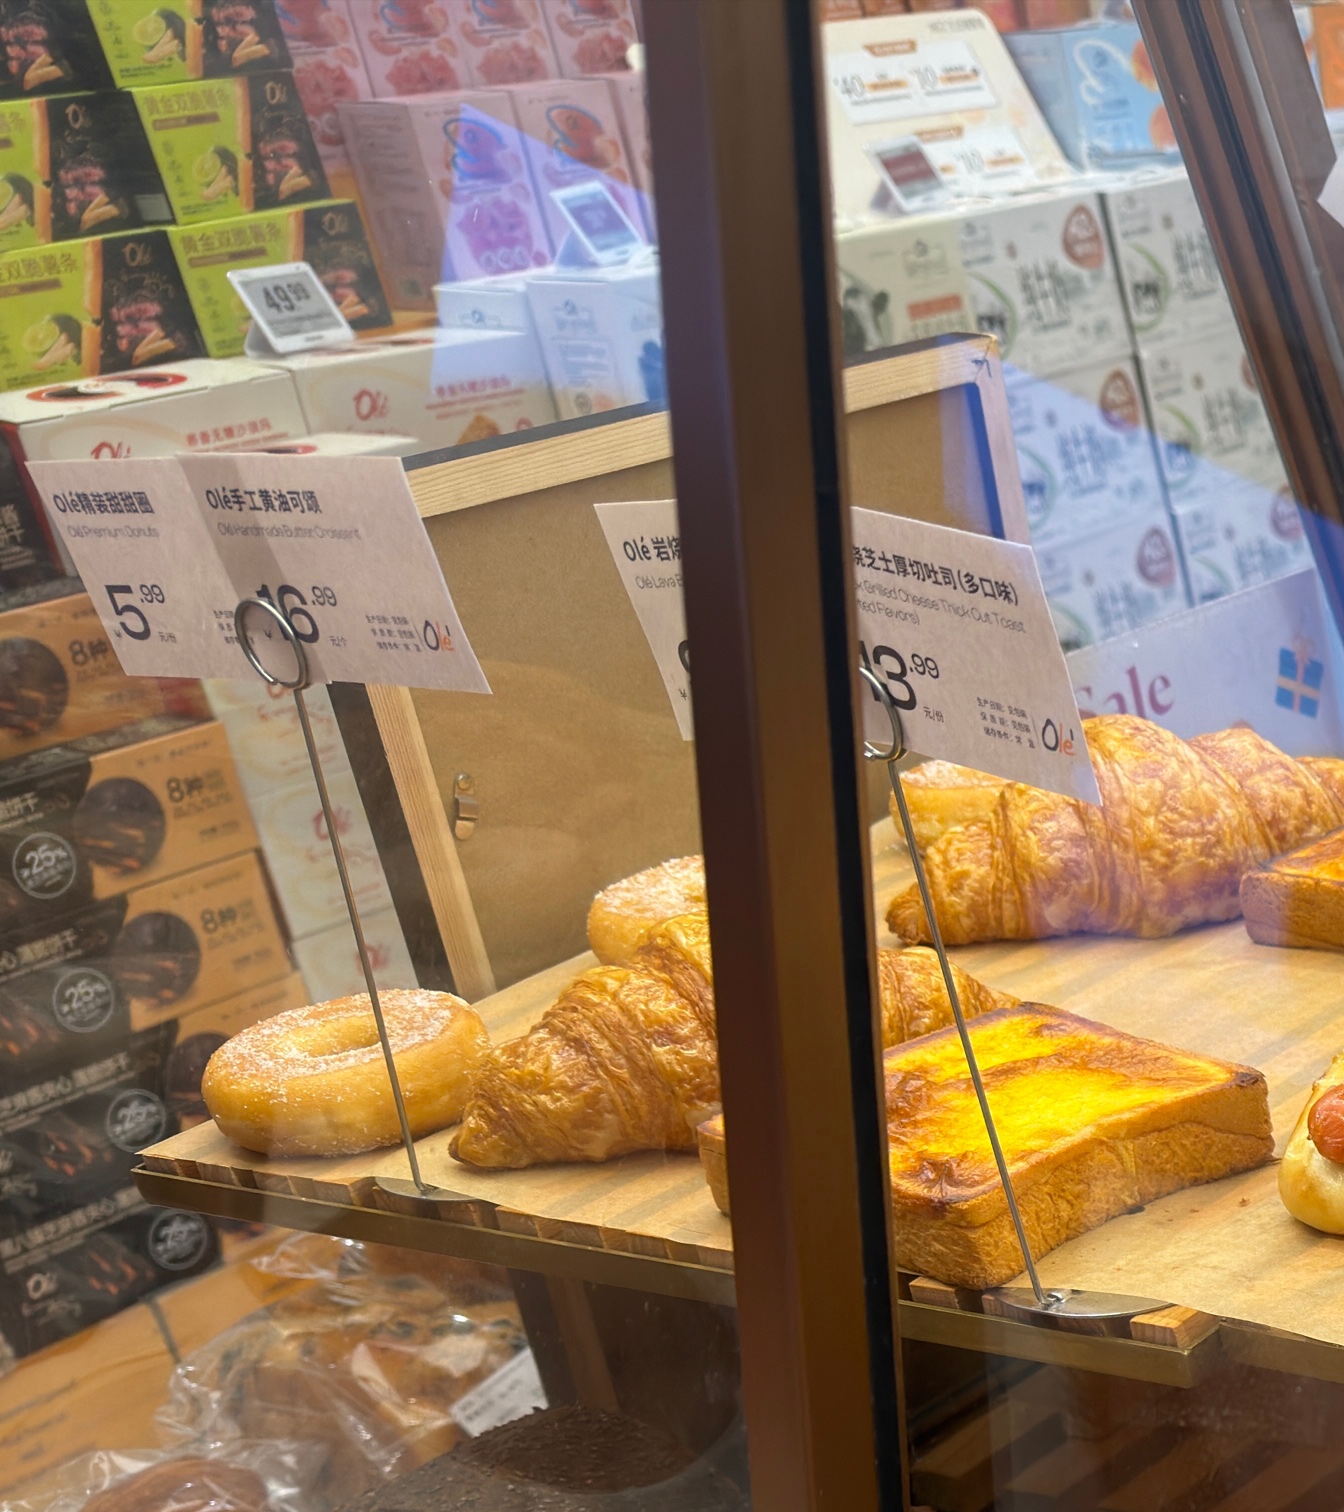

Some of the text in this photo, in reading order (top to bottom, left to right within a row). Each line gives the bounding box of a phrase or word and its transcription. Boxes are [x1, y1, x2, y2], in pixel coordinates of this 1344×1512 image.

[206, 487, 322, 514] Olé手工黄油可颂
[104, 584, 165, 641] 5.99
[1041, 718, 1076, 757] Olé
